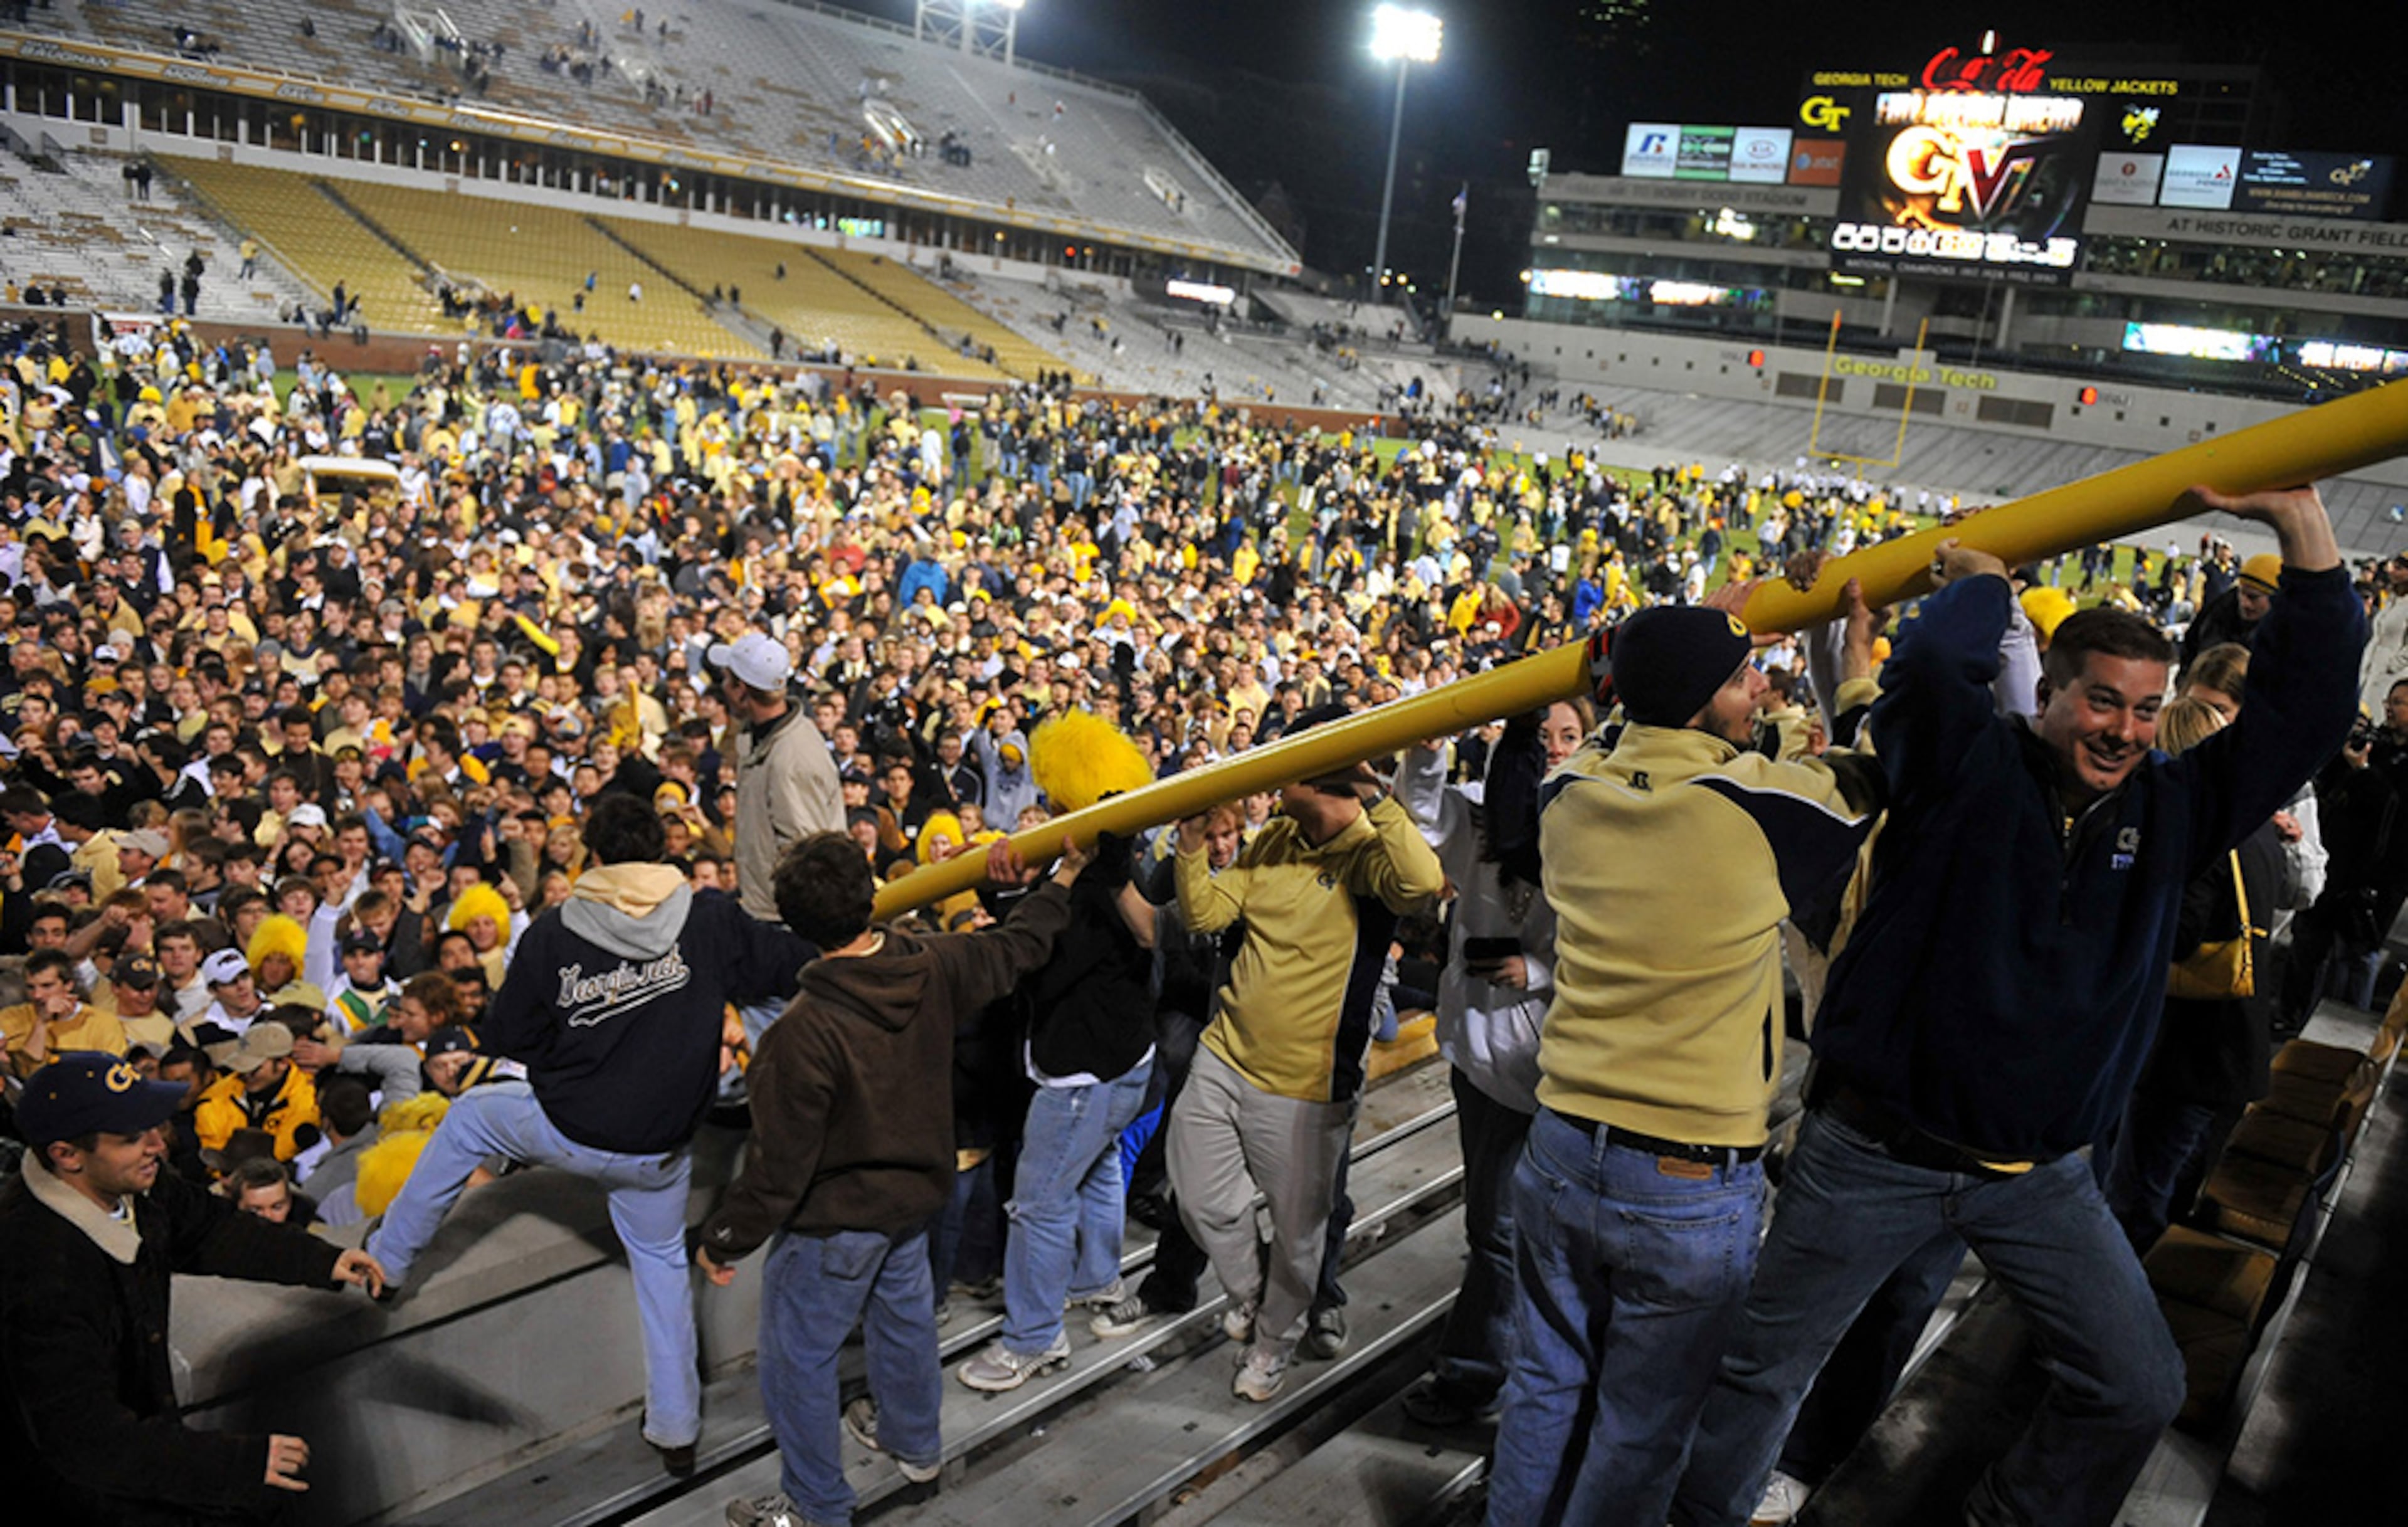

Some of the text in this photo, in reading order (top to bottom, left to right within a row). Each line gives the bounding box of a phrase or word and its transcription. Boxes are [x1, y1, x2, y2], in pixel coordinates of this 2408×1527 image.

[1812, 71, 1910, 86] GEORGIA TECH
[2049, 78, 2178, 95] YELLOW JACKETS
[1799, 96, 1851, 132] GT
[2167, 218, 2408, 247] AT HISTORIC GRANT FIELD
[1834, 355, 1997, 389] Georga Tech
